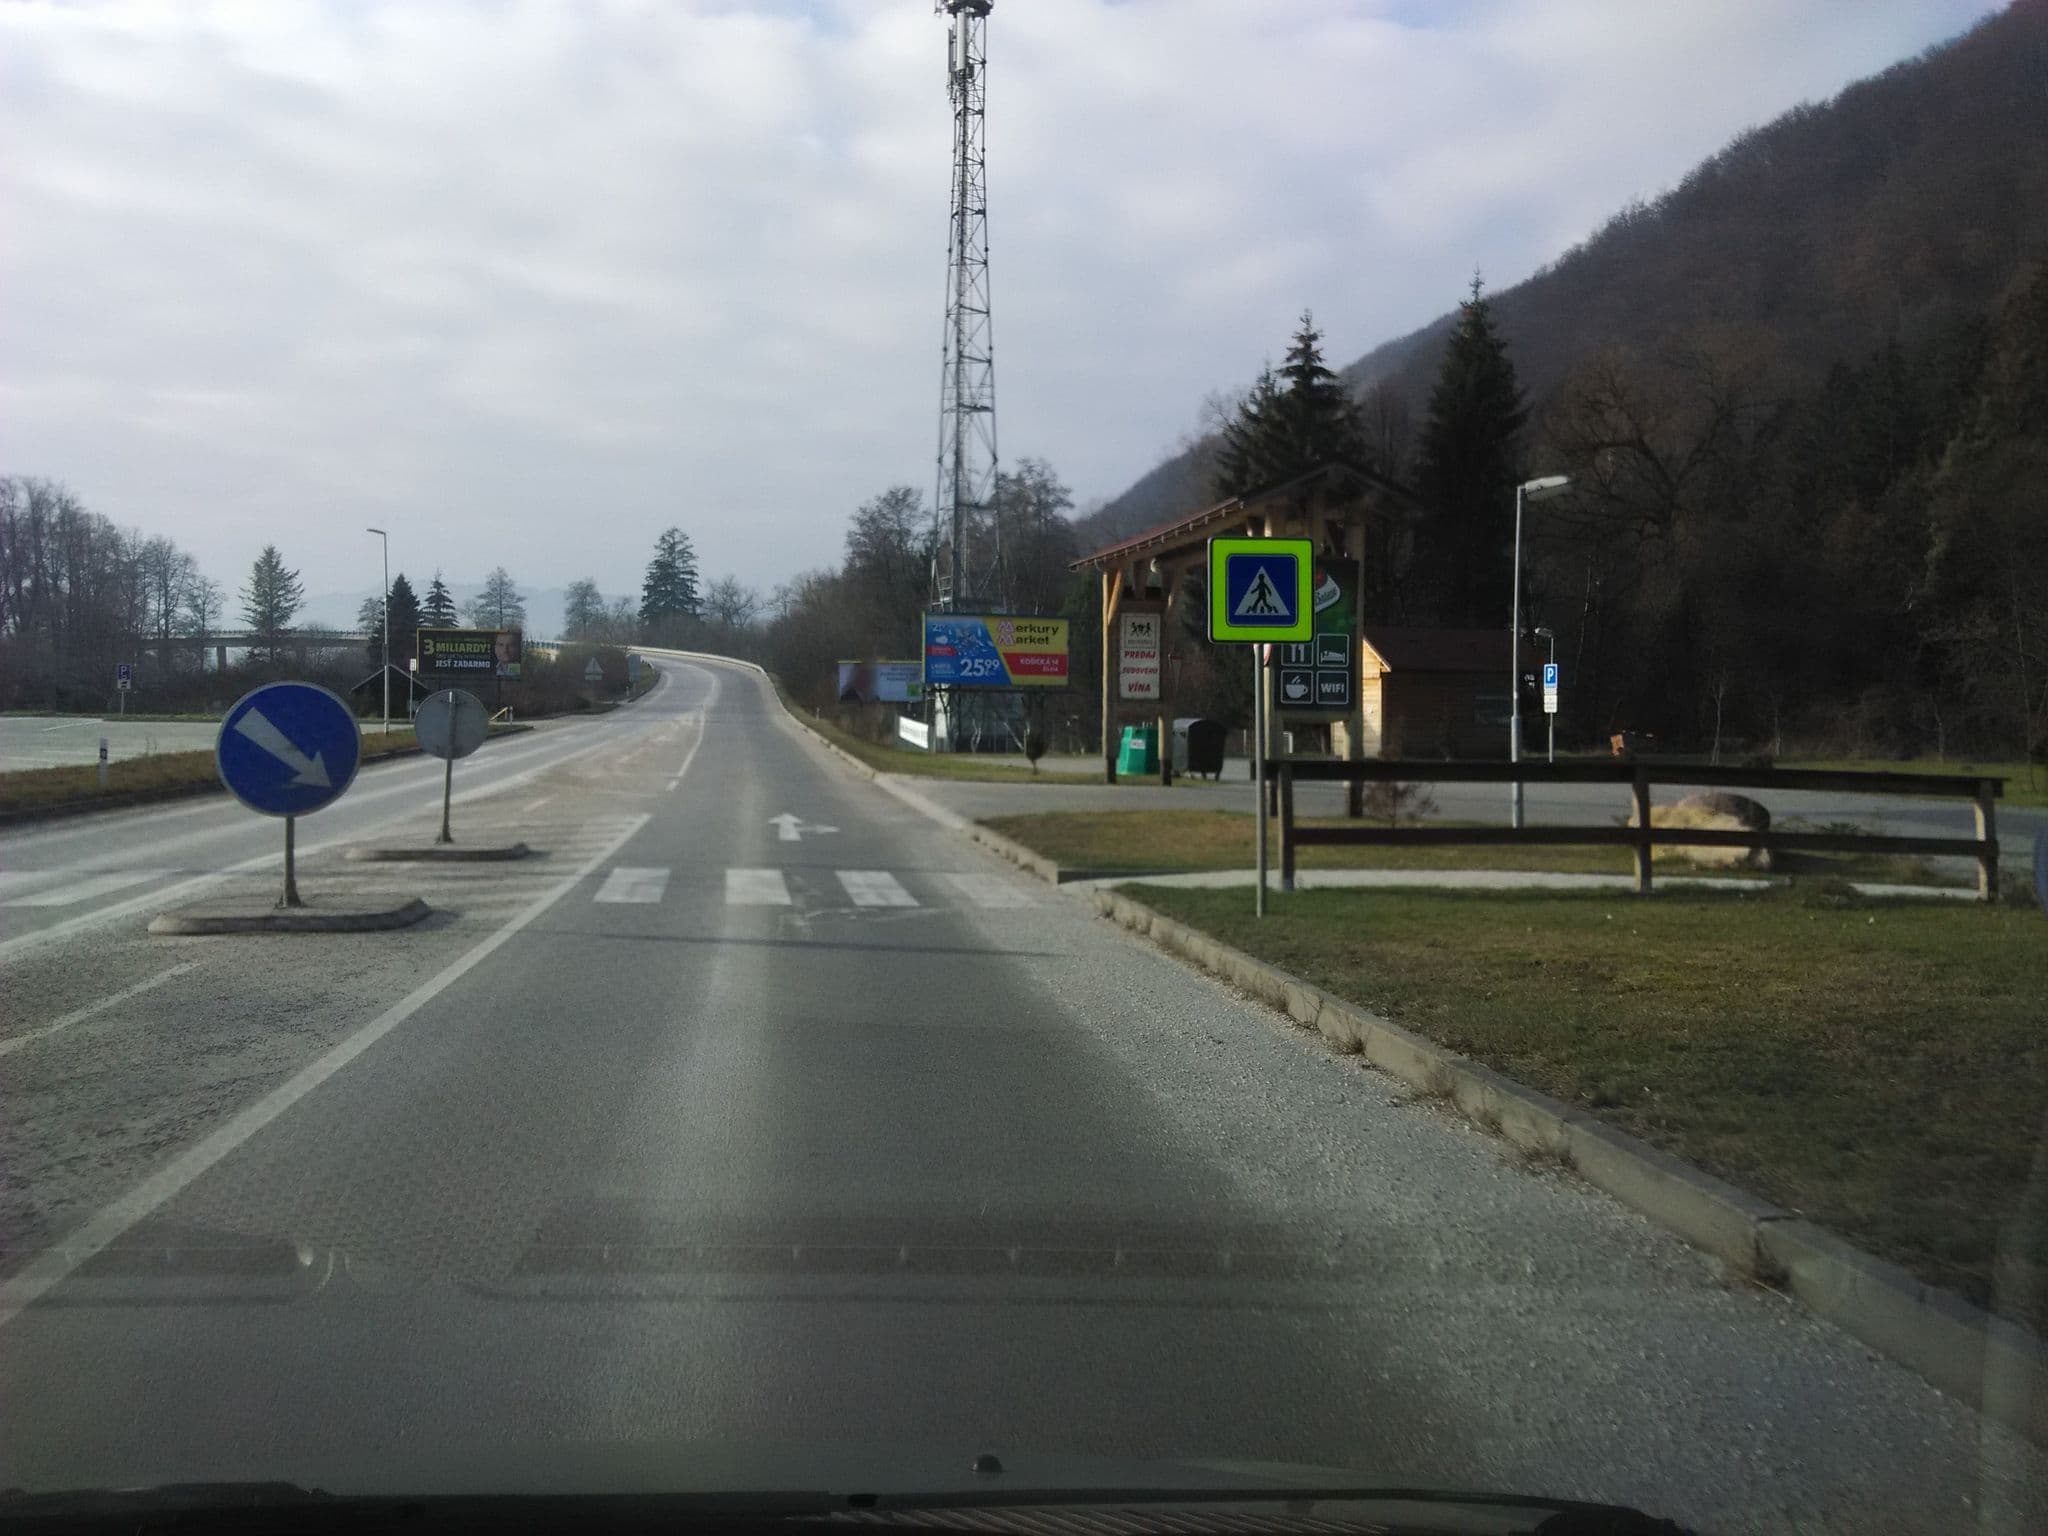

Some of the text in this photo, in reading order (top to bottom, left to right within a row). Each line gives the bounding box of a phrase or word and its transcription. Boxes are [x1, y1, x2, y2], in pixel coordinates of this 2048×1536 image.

[999, 621, 1059, 635] Merkury
[999, 635, 1049, 645] Market
[423, 639, 491, 655] 3 MILIARDY!
[1124, 650, 1156, 660] PREDAJ
[453, 660, 491, 669] ZADARMO
[1547, 667, 1554, 682] P
[1127, 681, 1151, 693] VÍNA
[1320, 683, 1345, 694] WIFI
